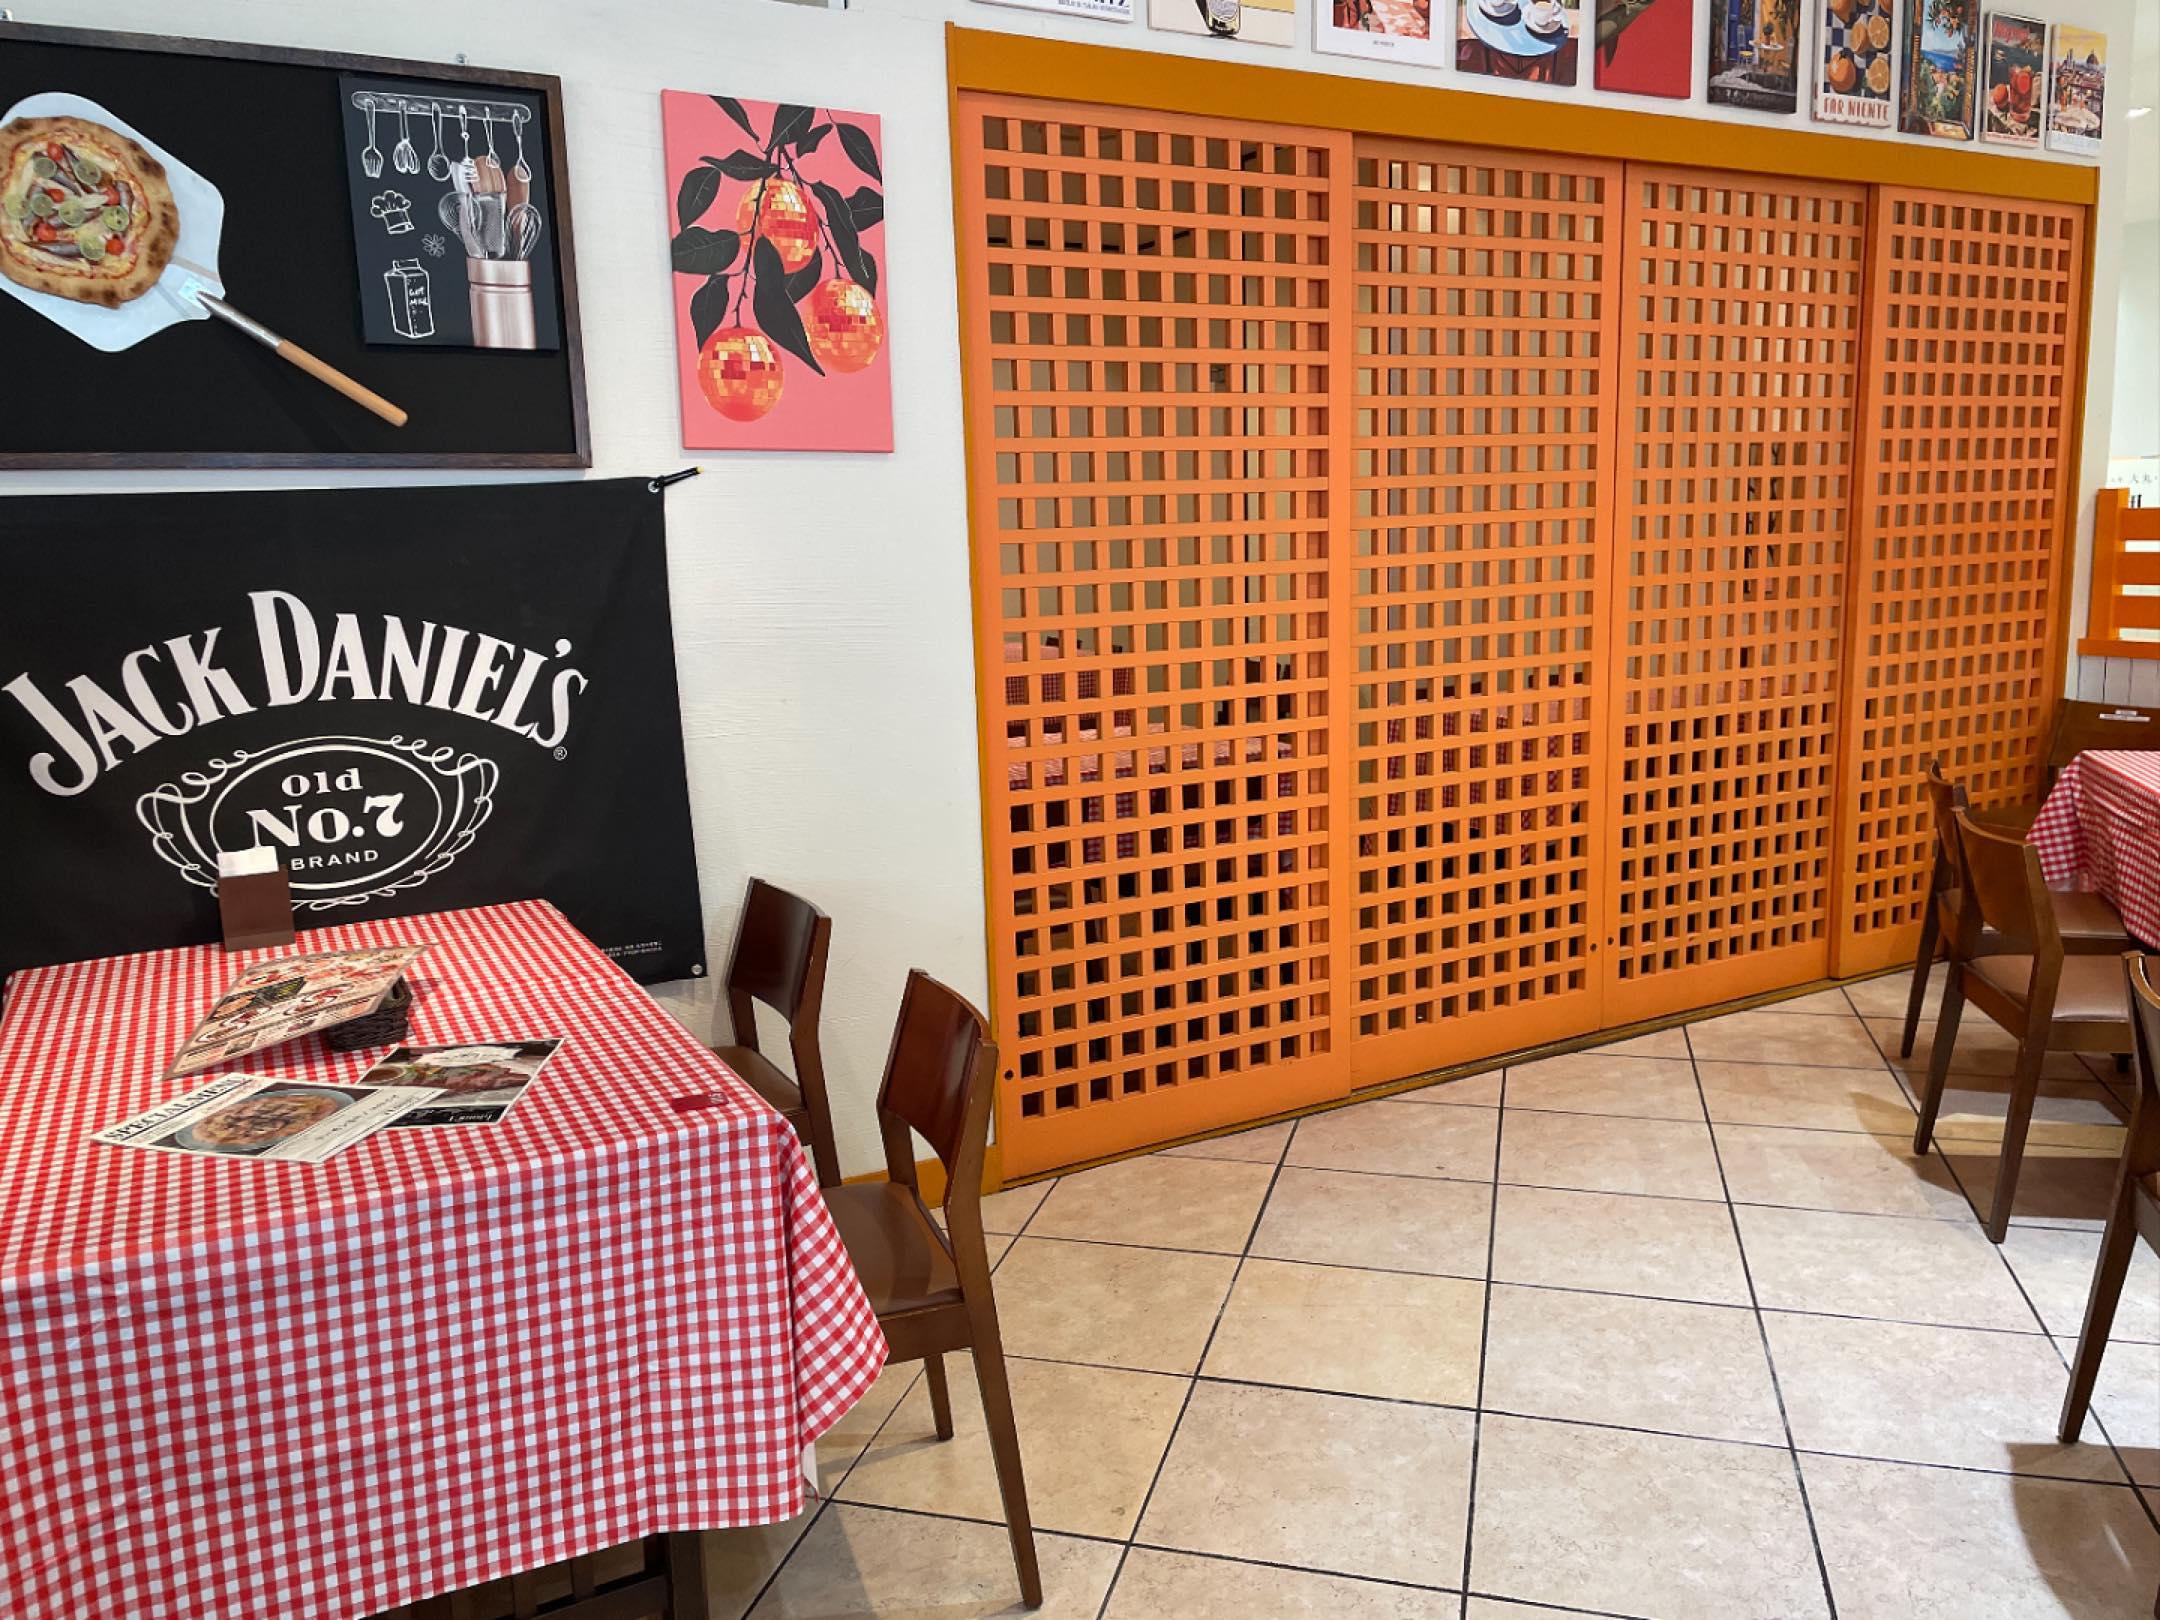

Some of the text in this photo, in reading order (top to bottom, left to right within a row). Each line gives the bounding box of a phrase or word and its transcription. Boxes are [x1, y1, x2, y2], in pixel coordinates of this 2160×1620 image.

[1823, 96, 1889, 121] FAR NIENTE
[1, 590, 589, 796] JACK DANIEL'S
[290, 850, 379, 871] BRAND
[104, 1103, 189, 1139] SPECIAL
